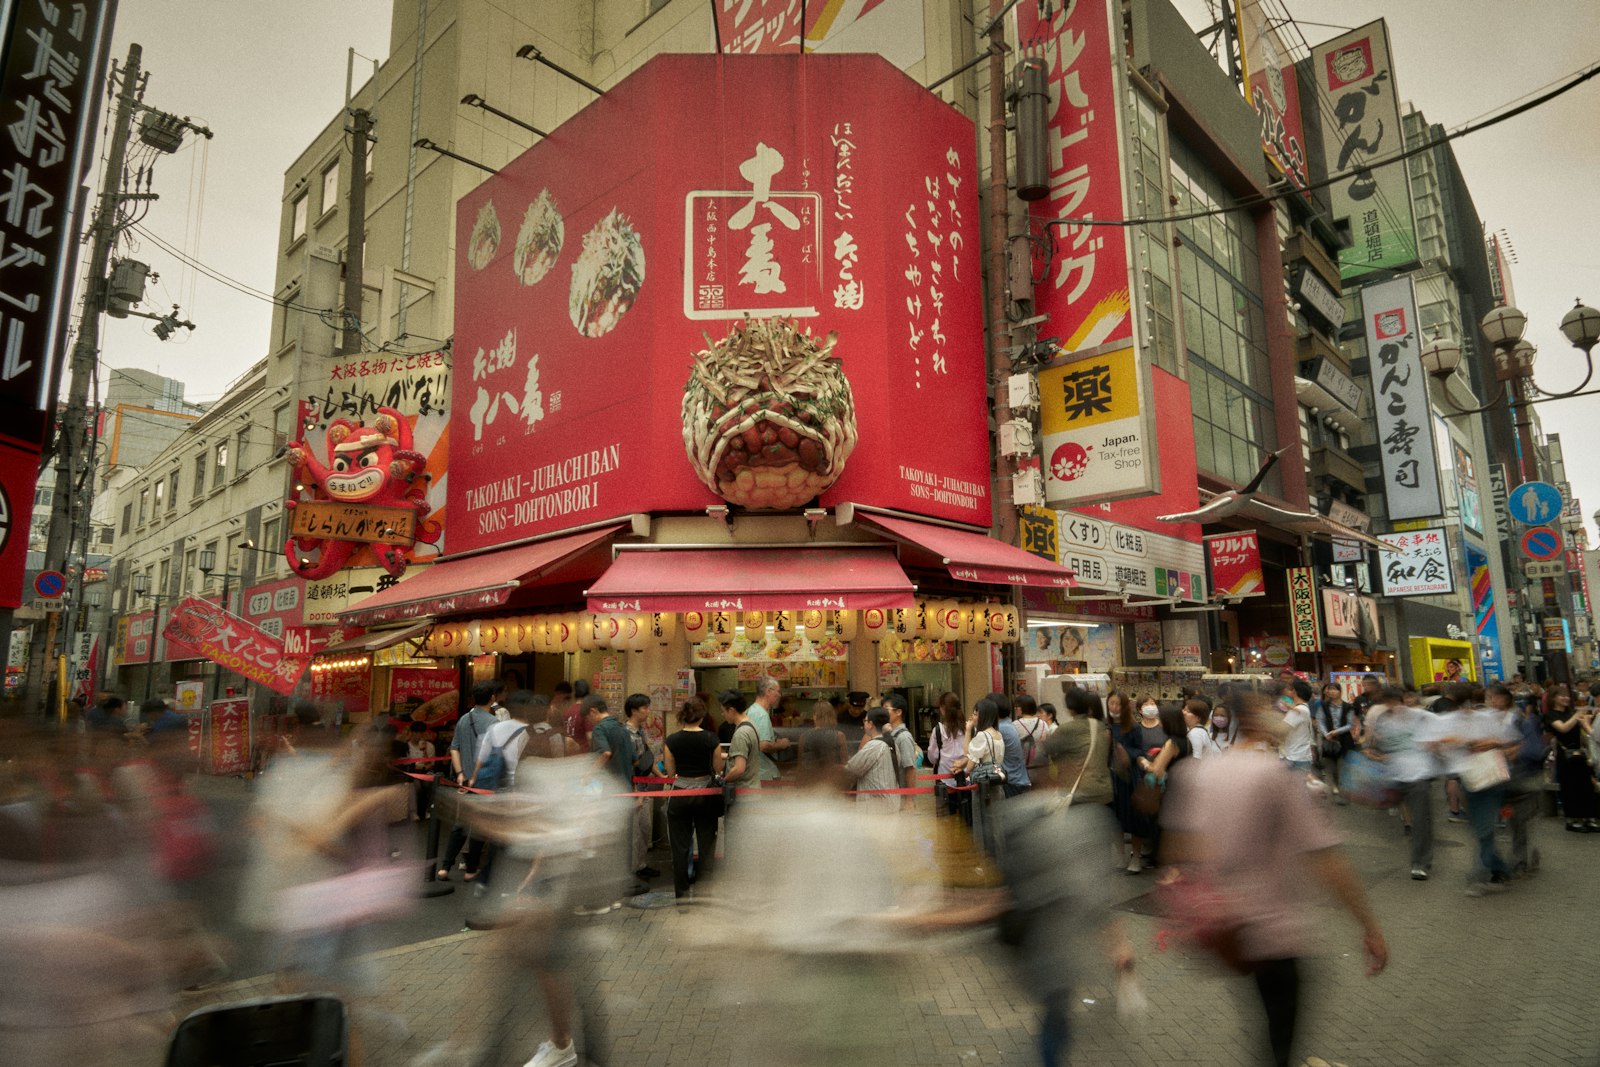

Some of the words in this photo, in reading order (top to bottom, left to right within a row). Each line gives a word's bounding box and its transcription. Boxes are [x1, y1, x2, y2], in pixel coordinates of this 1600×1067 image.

[728, 141, 801, 294] 十八番
[1362, 211, 1383, 263] 道頓堀店
[1063, 365, 1112, 421] 薬
[1098, 446, 1141, 461] Tax-free
[1102, 433, 1139, 448] Japan.
[1114, 458, 1141, 470] Shop
[466, 444, 620, 512] TAKOYAKI-JUHACHIBAN
[899, 465, 985, 497] TAKOYAKI-JUHACHIBAN
[479, 482, 598, 535] SONS-DOHTONBORI
[910, 483, 978, 510] SONS-DOHTONBORI
[1024, 511, 1056, 561] 薬
[1069, 520, 1100, 544] くすり
[1115, 530, 1143, 553] 化粧品
[1211, 536, 1257, 554] ツルハ
[1383, 533, 1441, 548] 食事処
[1071, 558, 1102, 581] 日用品
[1213, 554, 1249, 566] ドラッグ
[1387, 557, 1446, 585] 和食
[1527, 564, 1562, 576] 自動車
[199, 642, 277, 685] TAKOYAKI
[221, 703, 240, 763] 大たこ焼
